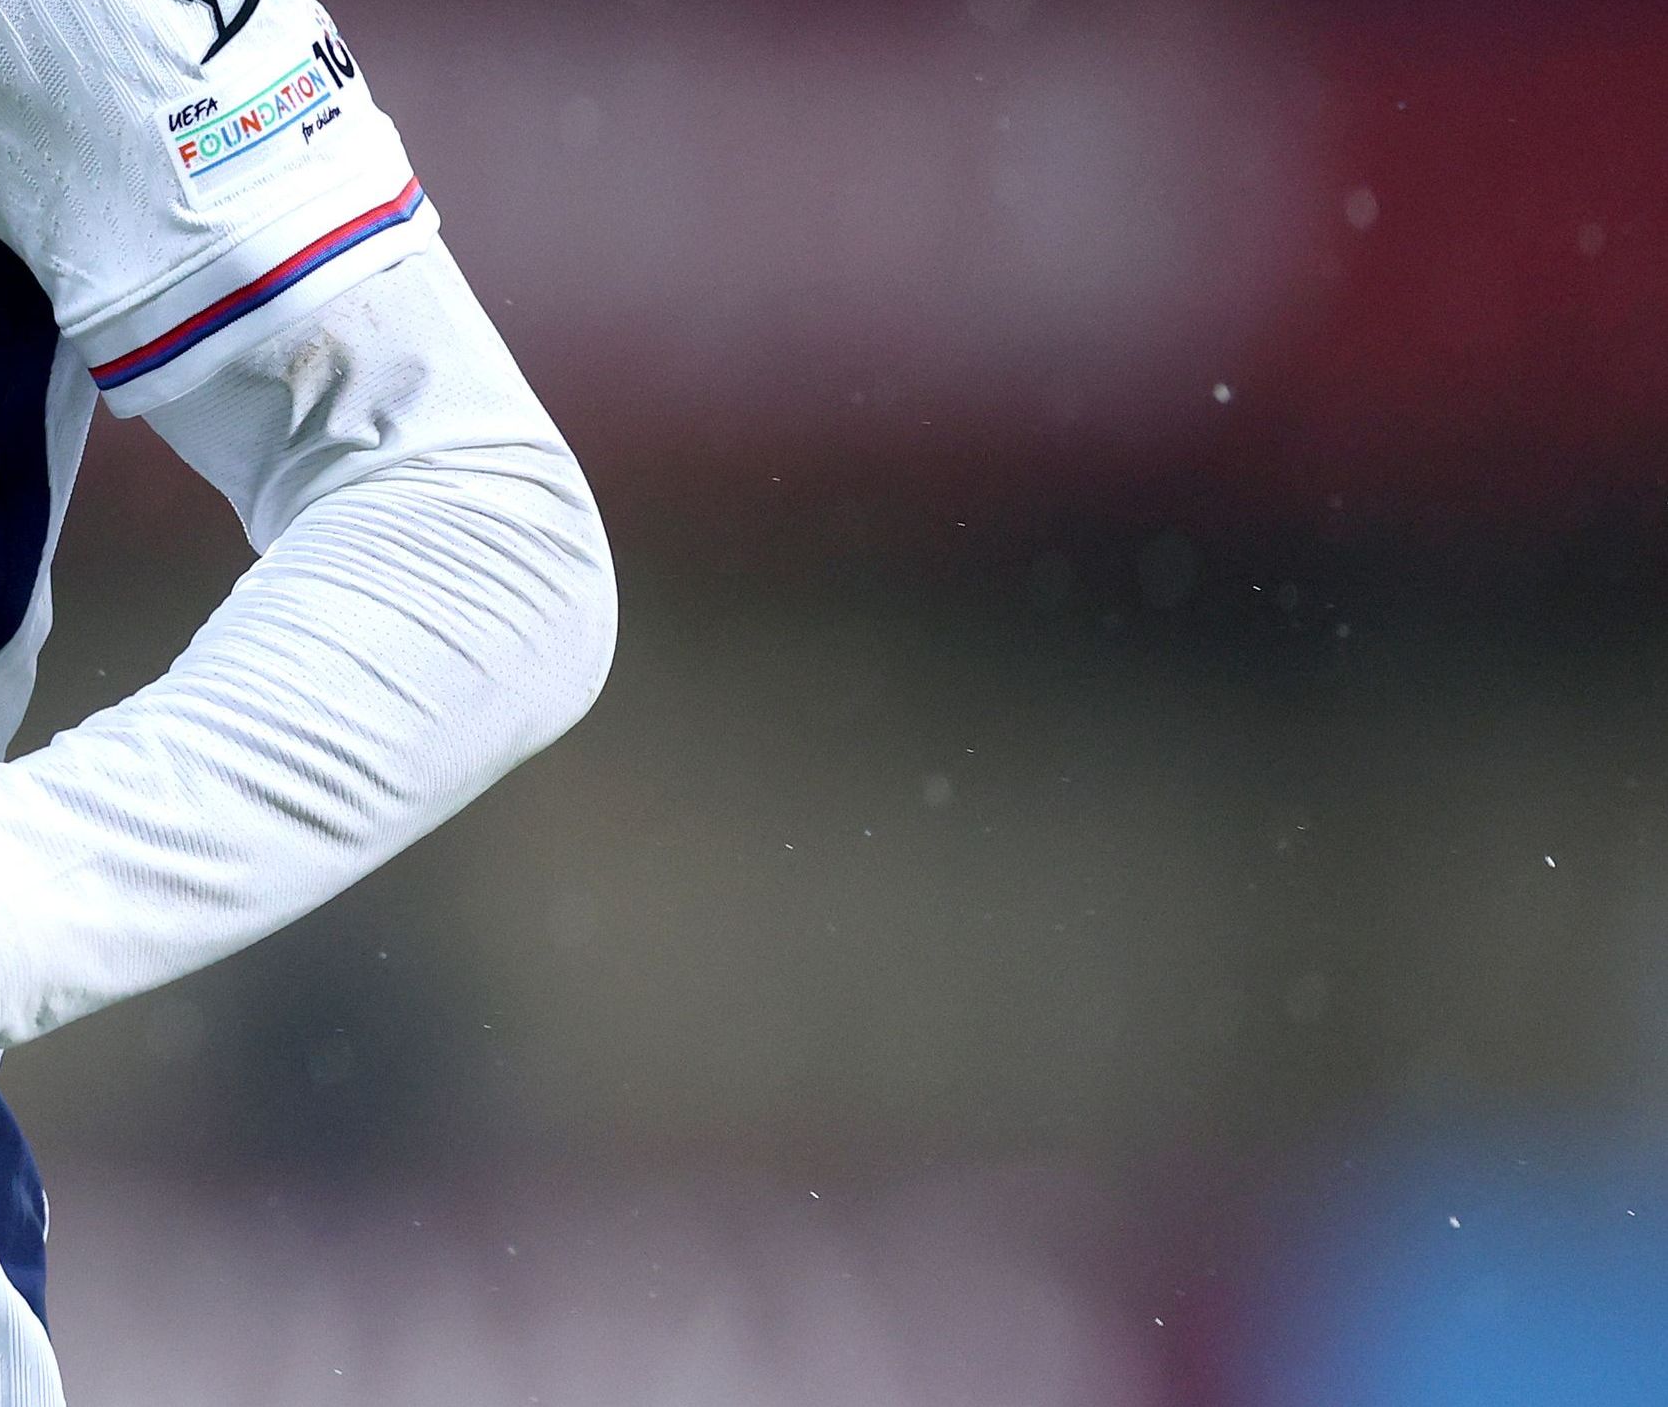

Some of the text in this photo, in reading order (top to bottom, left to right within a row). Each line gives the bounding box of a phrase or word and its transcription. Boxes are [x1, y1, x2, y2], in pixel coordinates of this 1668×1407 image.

[168, 96, 219, 132] UEFA
[178, 66, 327, 169] FOUNDATION
[301, 121, 314, 144] for
